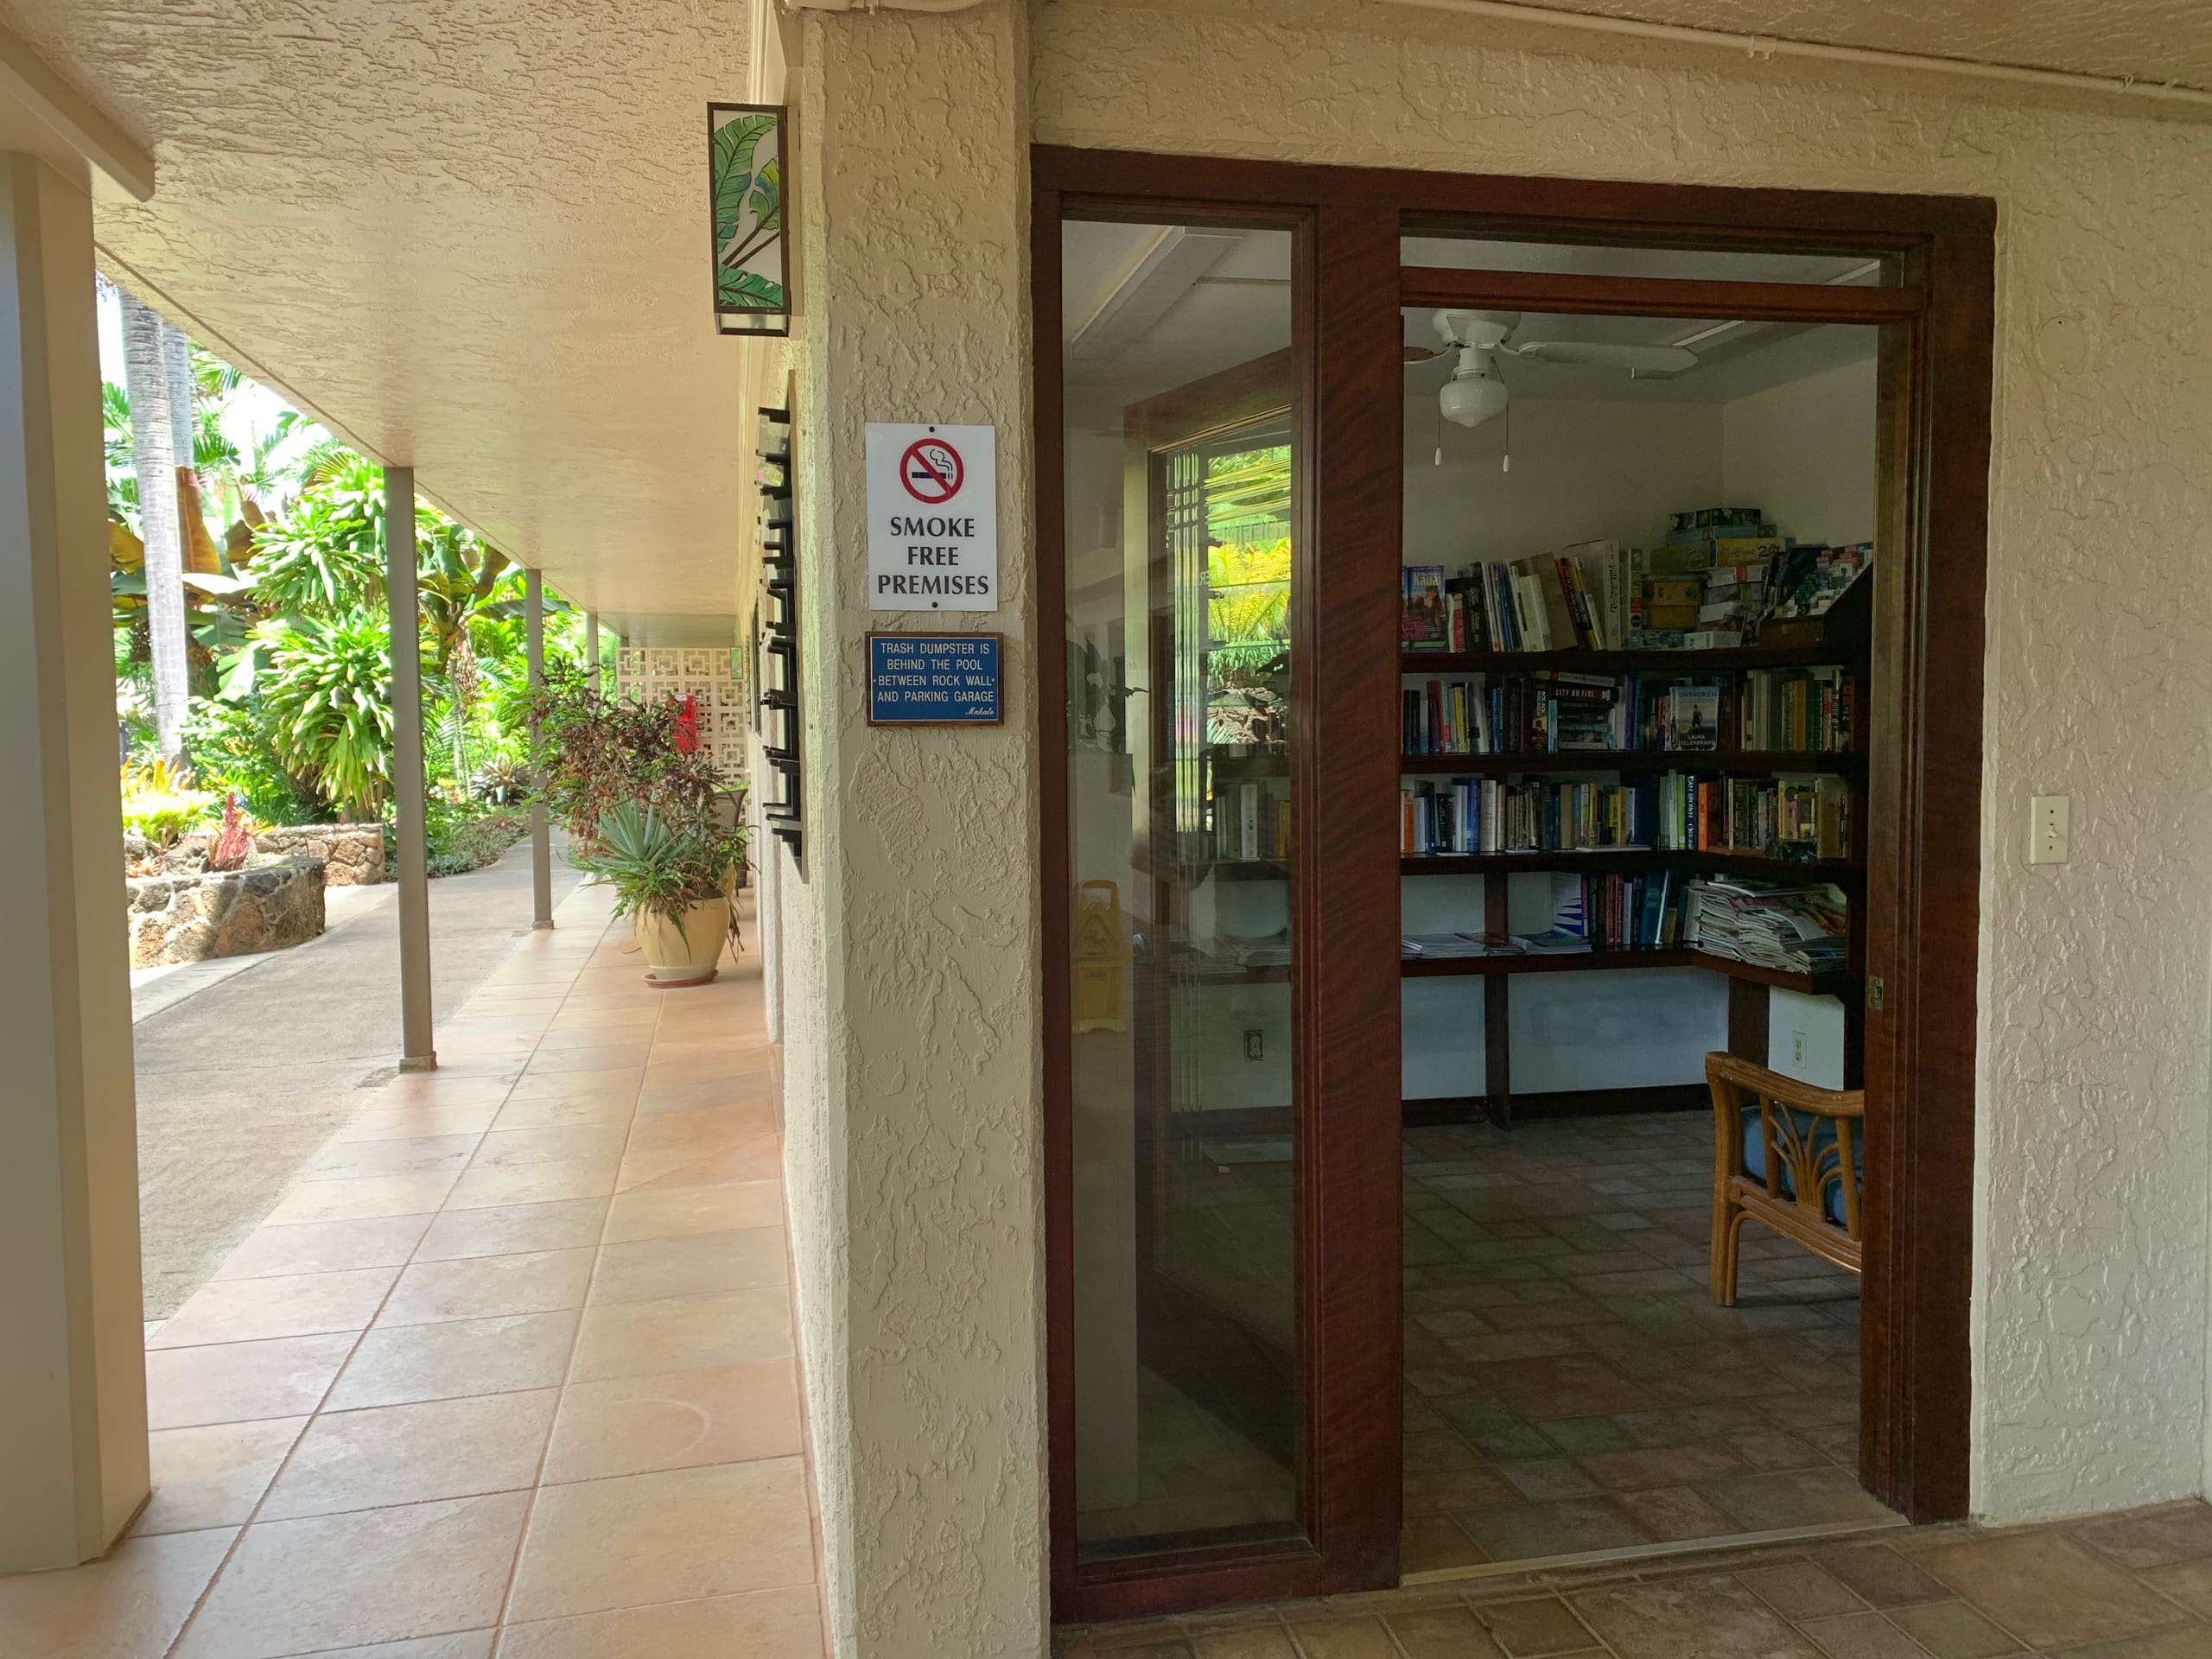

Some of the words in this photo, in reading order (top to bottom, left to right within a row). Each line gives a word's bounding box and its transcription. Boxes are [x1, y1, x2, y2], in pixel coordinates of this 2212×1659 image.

[890, 517, 975, 537] SMOKE
[907, 546, 959, 566] FREE
[878, 575, 989, 594] PREMISES
[880, 642, 914, 654] TRASH
[919, 643, 974, 654] DUMPSTER
[980, 643, 989, 654] IS
[887, 658, 925, 671] BEHIND
[931, 658, 950, 671] THE
[956, 659, 983, 671] POOL
[878, 675, 926, 686] BETWEEN
[932, 675, 960, 686] ROCK
[965, 675, 993, 686] WALL
[877, 691, 899, 702] AND
[905, 691, 949, 702] PARKING
[954, 691, 994, 702] GARAGE
